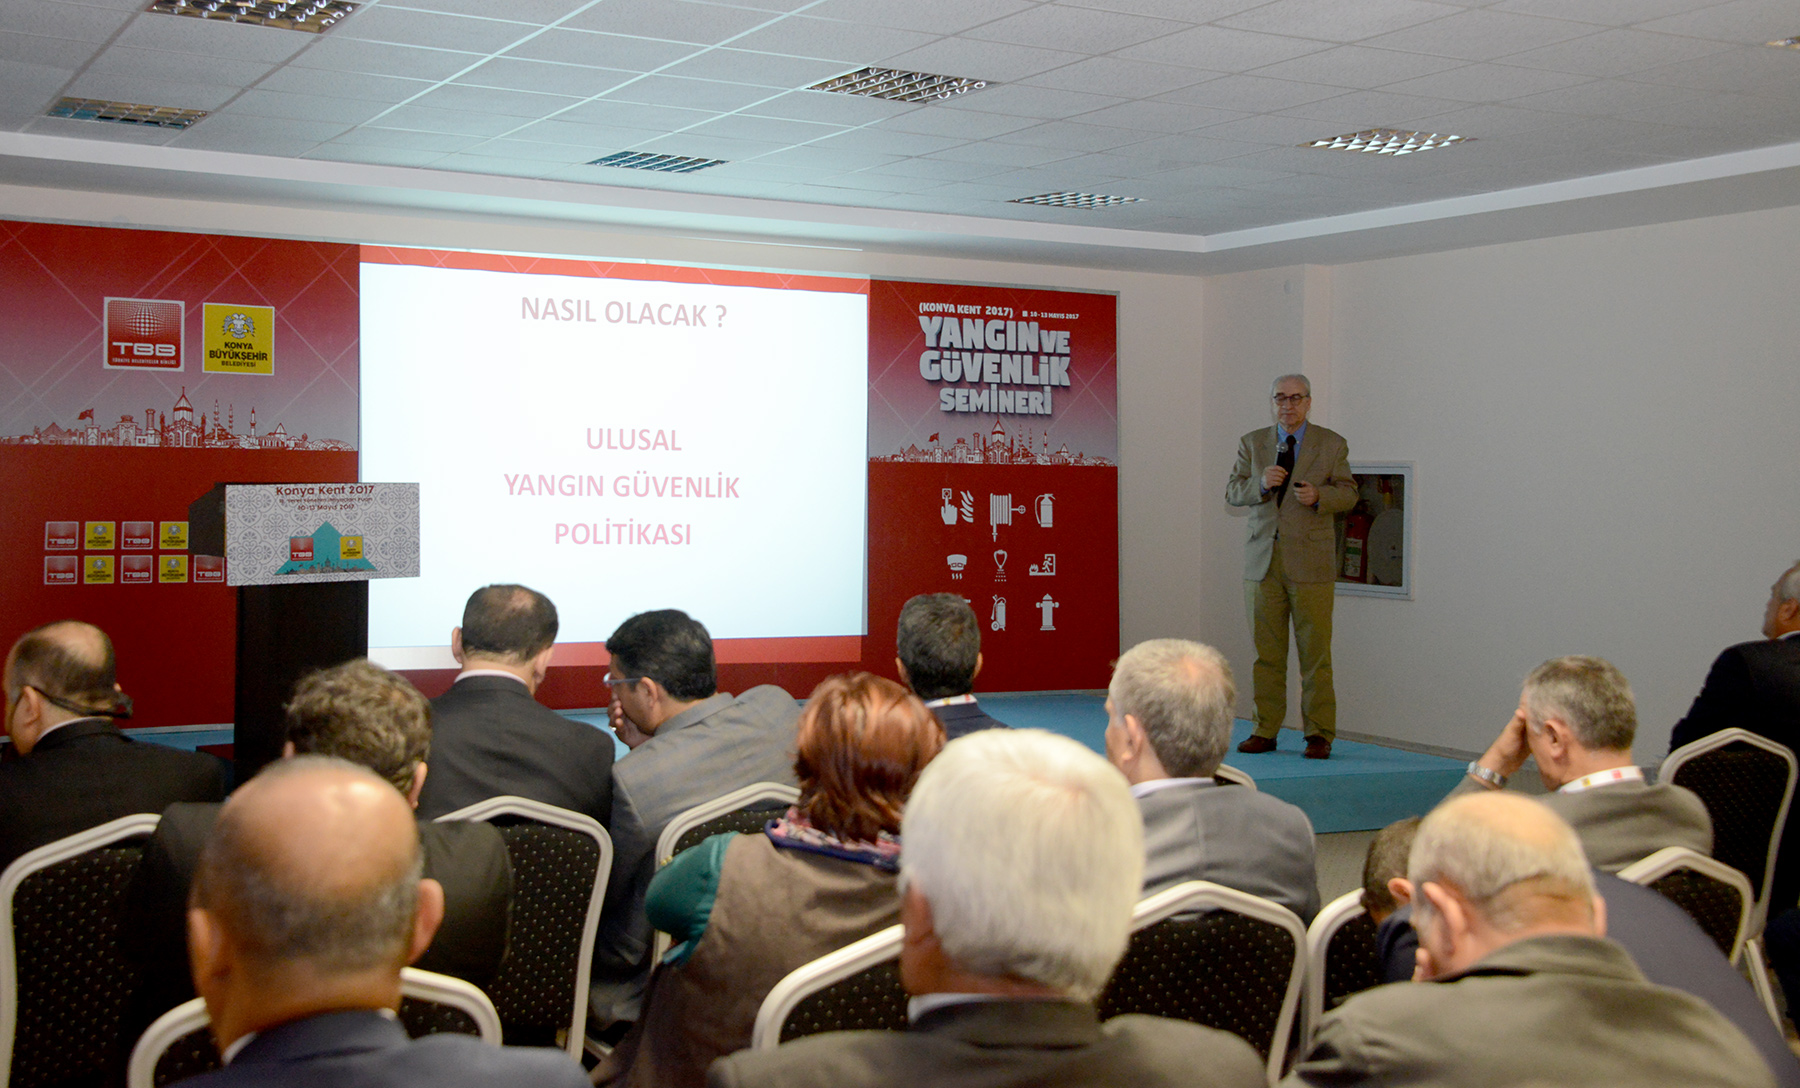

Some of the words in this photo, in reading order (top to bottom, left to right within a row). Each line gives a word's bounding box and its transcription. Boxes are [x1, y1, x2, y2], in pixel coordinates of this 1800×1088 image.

[521, 297, 597, 322] NASIL
[604, 301, 707, 327] OLACAK
[715, 304, 727, 328] ?
[918, 302, 956, 314] (KONYA
[957, 304, 982, 315] KENT
[985, 305, 1014, 319] 2017)
[1048, 312, 1065, 320] MAYIS
[918, 315, 1040, 353] YANGIN
[1040, 329, 1071, 354] VE
[112, 341, 176, 357] TBB
[209, 348, 268, 362] BÜYÜKŞEHİR
[224, 341, 254, 350] KONYA
[221, 360, 256, 368] BELEDİYESİ
[918, 350, 1071, 387] GÜVENLİK
[939, 383, 1052, 415] SEMİNERİ
[586, 427, 682, 451] ULUSAL
[276, 486, 315, 497] Konya
[318, 485, 346, 495] Kent
[349, 485, 375, 494] 2017
[503, 473, 604, 497] YANGIN
[613, 470, 740, 499] GÜVENLİK
[555, 517, 691, 545] POLİTİKASI
